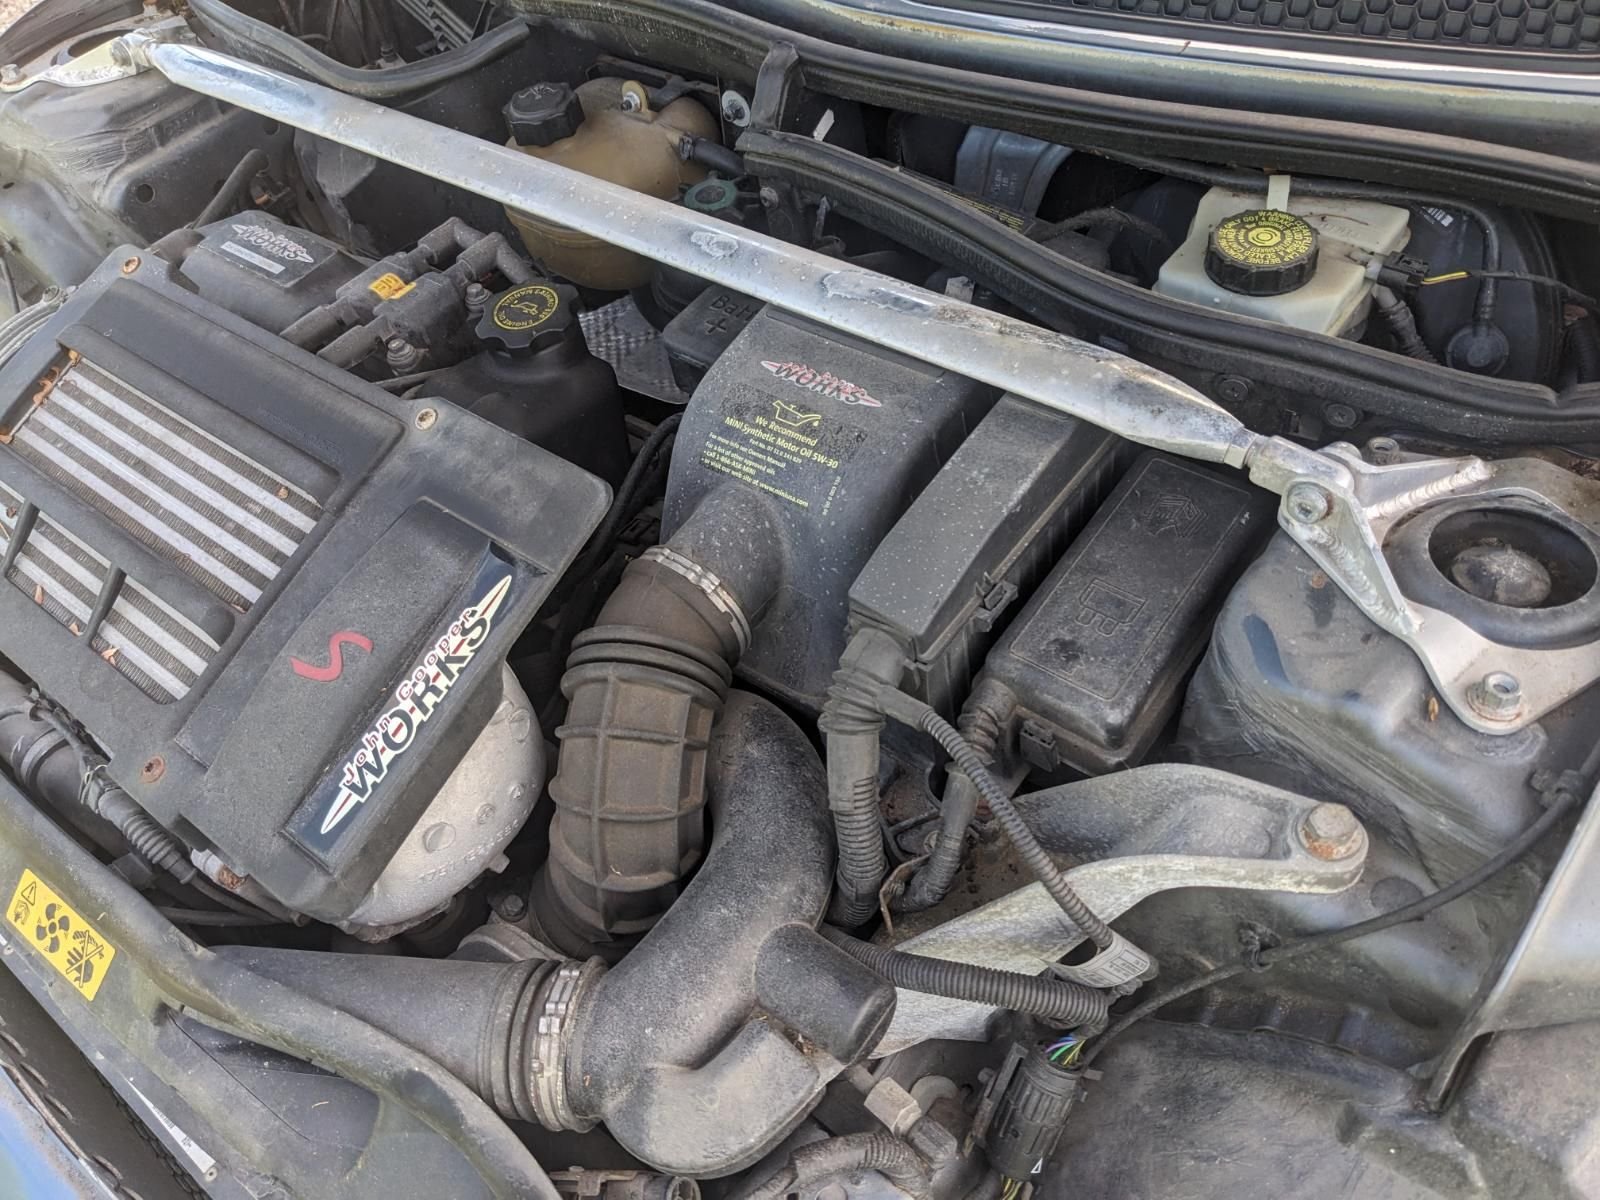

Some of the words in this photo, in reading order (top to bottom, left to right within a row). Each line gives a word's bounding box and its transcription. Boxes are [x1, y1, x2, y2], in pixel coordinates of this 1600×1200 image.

[1258, 211, 1296, 221] WARNING
[1268, 216, 1294, 228] BRAKE
[1292, 226, 1303, 240] FLUID
[1295, 220, 1311, 236] CLEAN
[1297, 236, 1312, 253] FILLER
[1243, 250, 1277, 259] SEALED
[1283, 252, 1299, 262] CAP
[755, 415, 768, 427] We
[768, 421, 818, 446] Recommend
[705, 441, 714, 449] For
[724, 416, 744, 430] MINI
[742, 424, 776, 444] Synthetic
[776, 437, 800, 453] Motor
[800, 447, 813, 458] Oil
[811, 452, 839, 469] 5W-30
[290, 629, 374, 683] S
[343, 713, 391, 784] John
[396, 607, 474, 702] Cooper
[342, 608, 490, 801] WORKS
